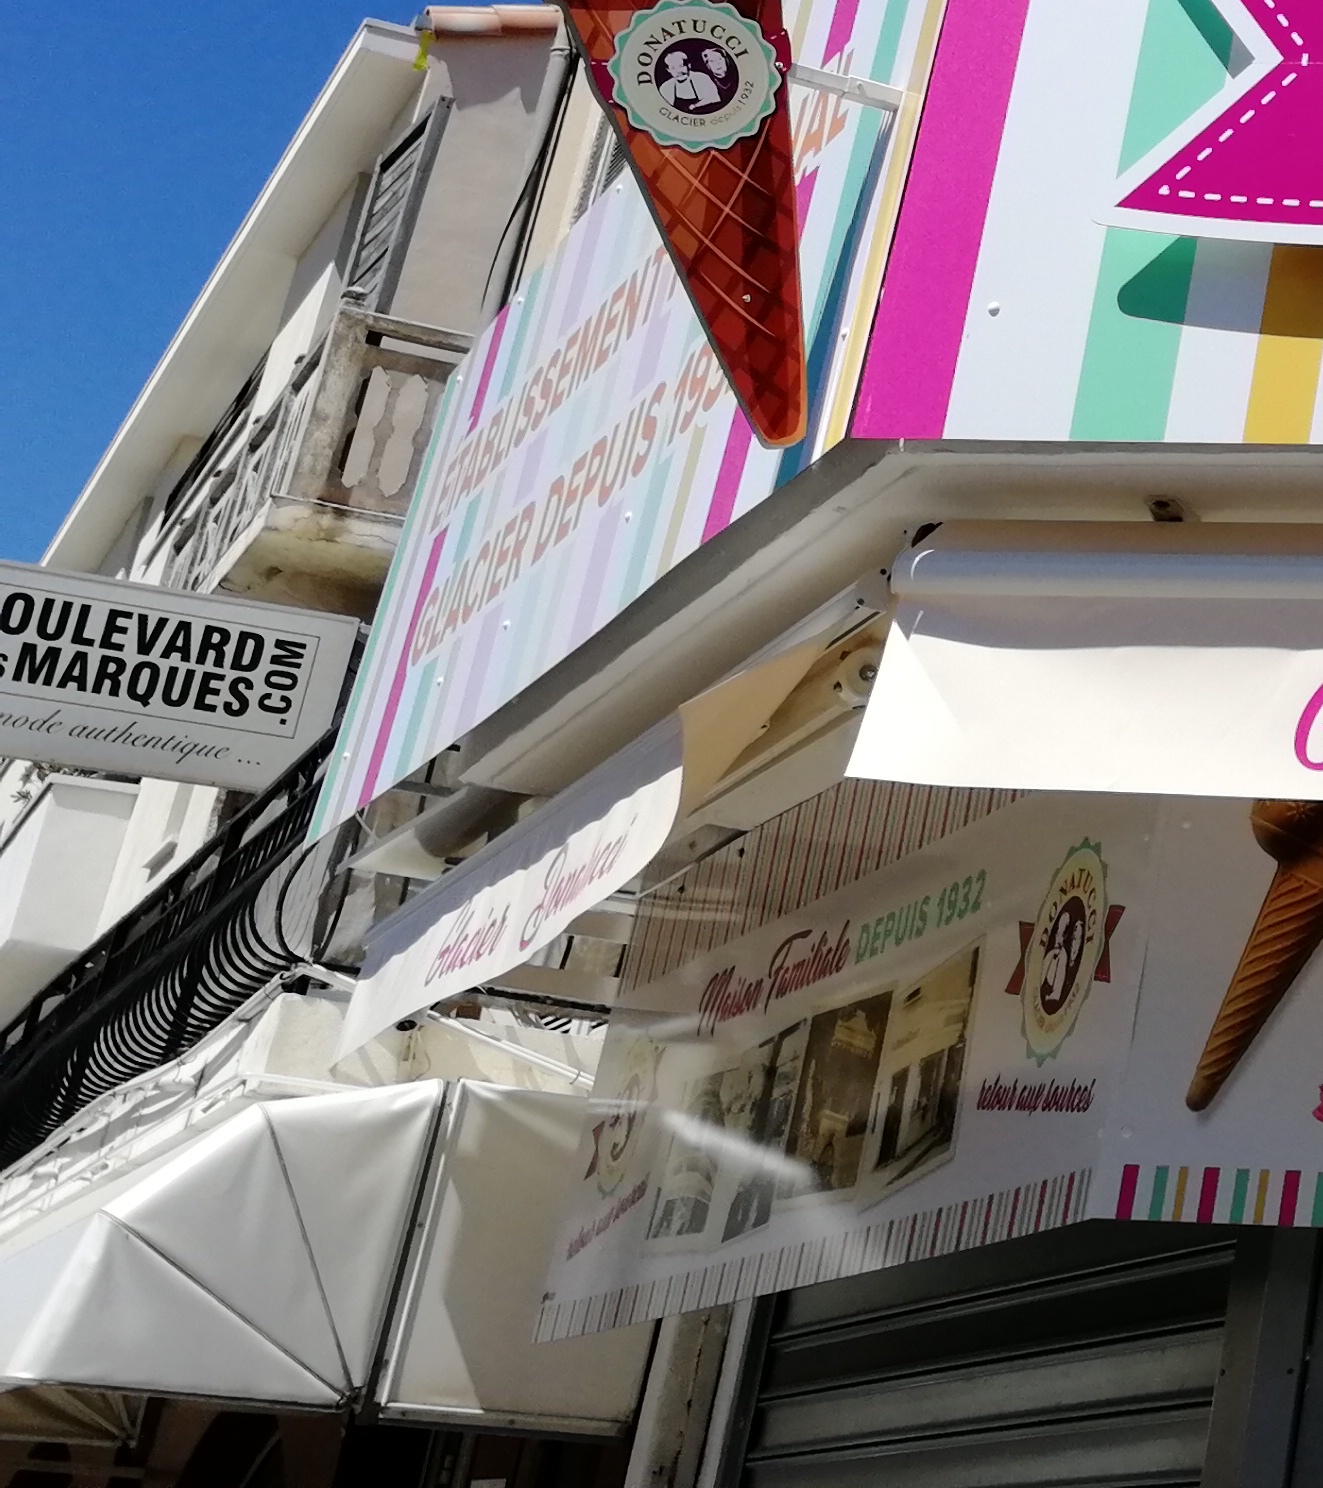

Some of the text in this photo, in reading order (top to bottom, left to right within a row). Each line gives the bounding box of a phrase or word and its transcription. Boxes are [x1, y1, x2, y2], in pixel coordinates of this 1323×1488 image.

[636, 18, 749, 86] DONATUCCI
[659, 107, 706, 128] GLACIER
[738, 80, 755, 105] 1932
[411, 501, 536, 666] GLACIER
[531, 380, 668, 567] DEPUIS
[0, 592, 265, 672] OULEVARD
[12, 642, 254, 717] MARQUES
[69, 721, 232, 764] authentique
[697, 868, 987, 1037] Maison Familiale DEPUIS 1932
